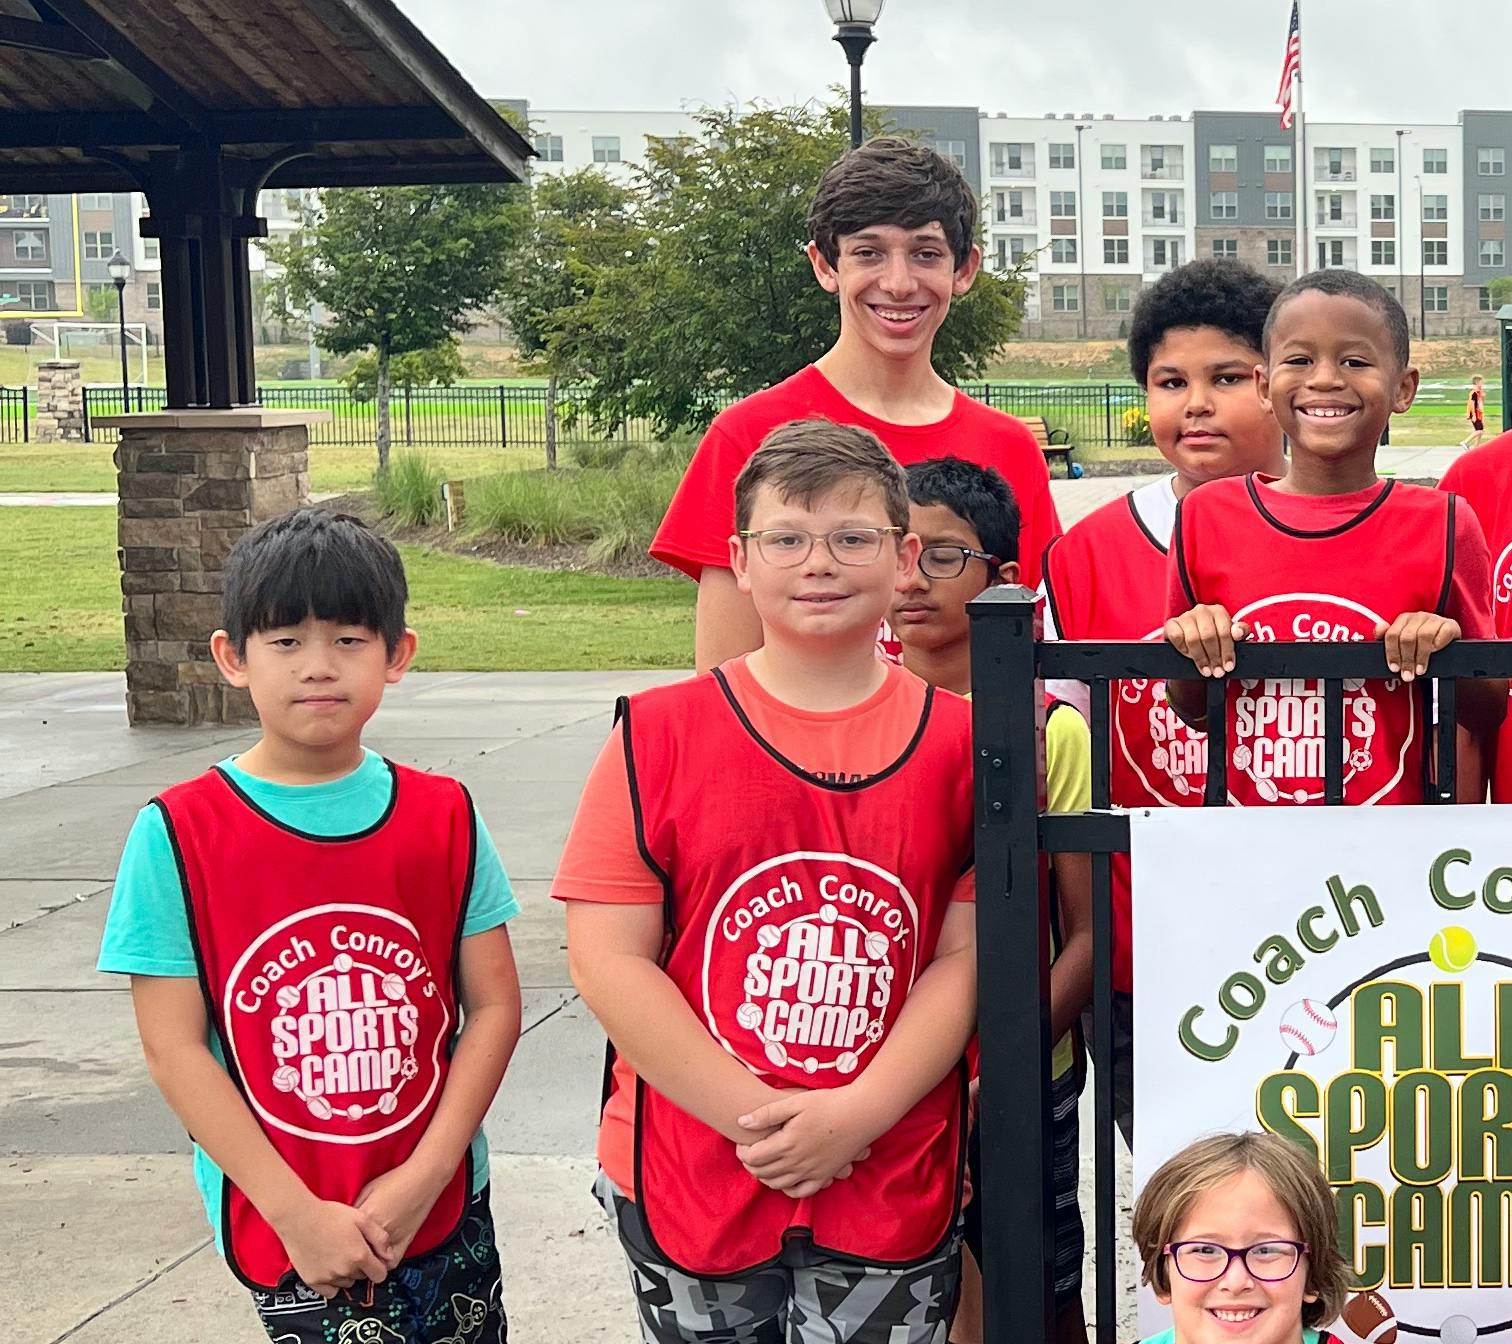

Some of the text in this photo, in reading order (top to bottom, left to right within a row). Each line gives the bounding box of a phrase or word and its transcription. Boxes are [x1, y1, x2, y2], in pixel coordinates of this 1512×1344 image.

[1253, 737, 1351, 779] CAM
[722, 874, 910, 950] Coach Conroy
[235, 925, 438, 1014] Coach Conroy's
[785, 922, 869, 965] ALL
[1178, 874, 1385, 1062] Coach
[306, 972, 389, 1013] ALL
[744, 953, 895, 1008] SPORTS
[271, 1004, 419, 1059] SPORTS
[763, 999, 870, 1049] CAMP
[300, 1046, 402, 1097] CAMP
